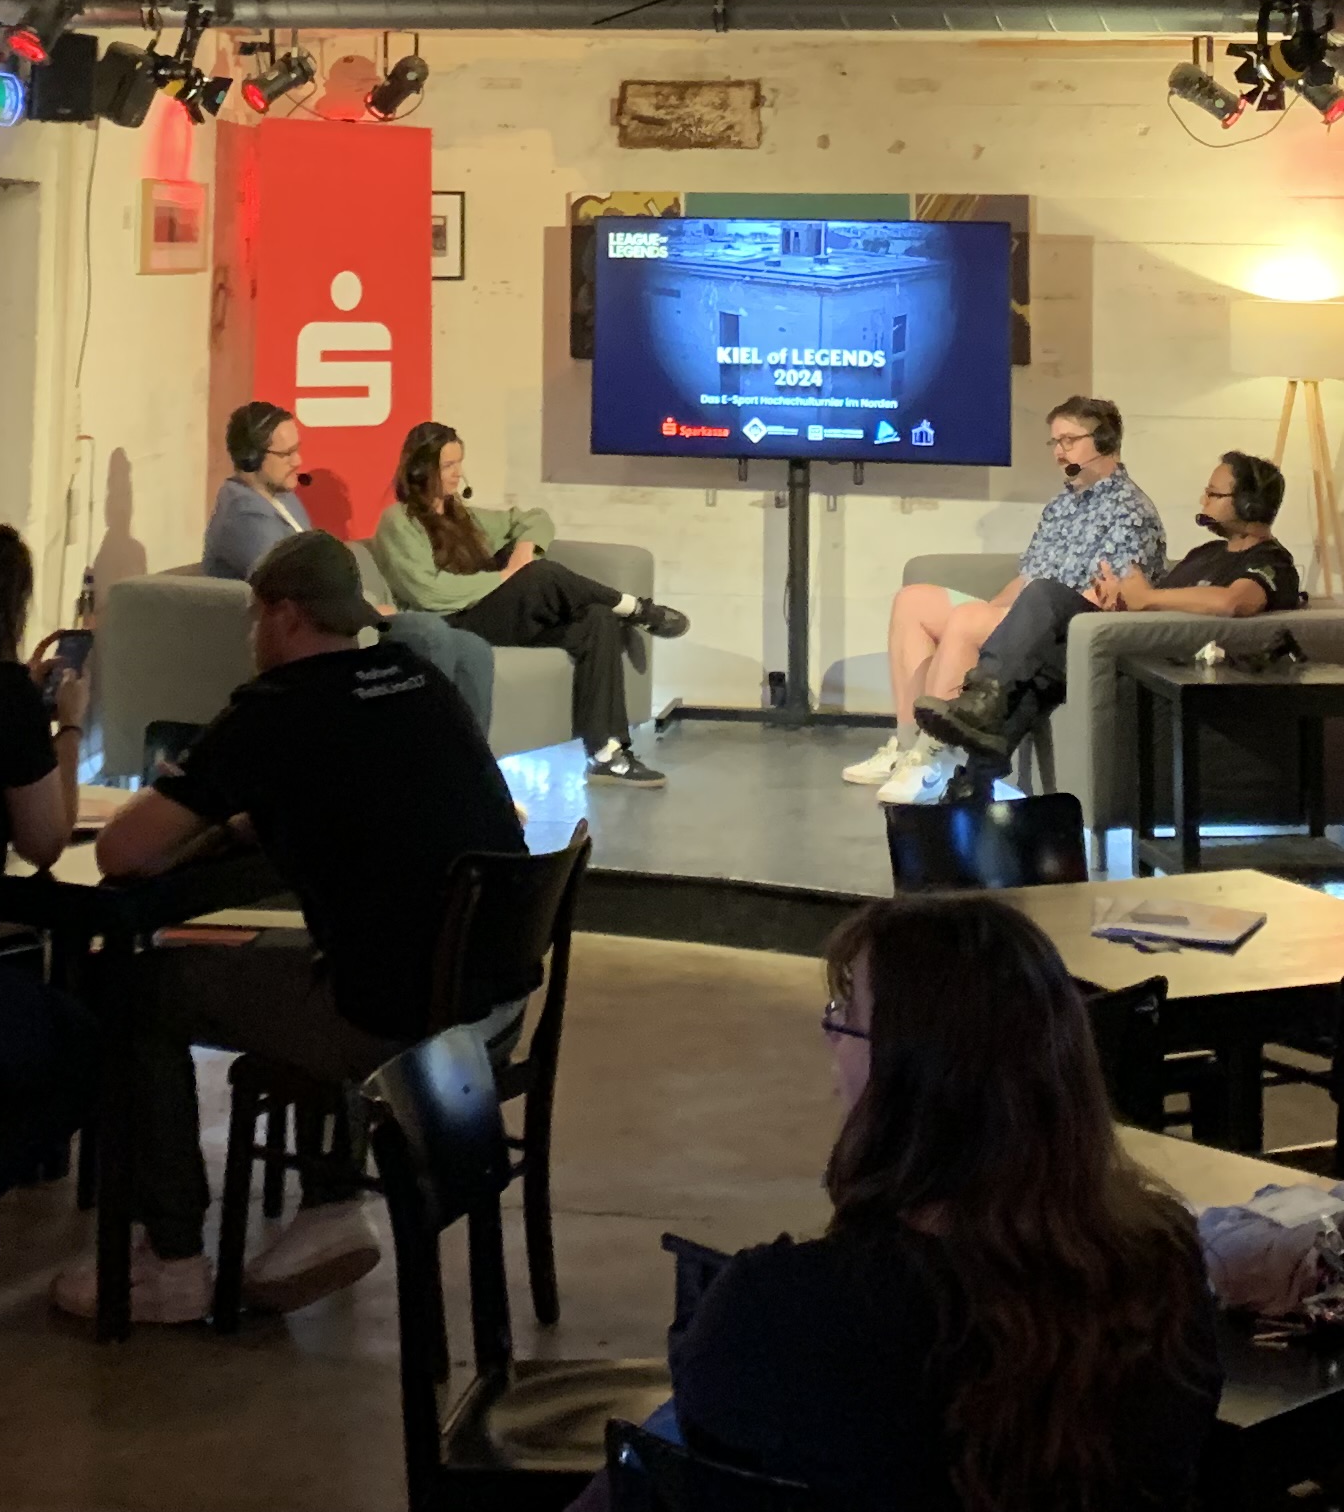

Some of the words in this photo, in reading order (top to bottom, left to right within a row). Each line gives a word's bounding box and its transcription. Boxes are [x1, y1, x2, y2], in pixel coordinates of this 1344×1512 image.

[608, 232, 660, 245] LEAGUE
[608, 245, 669, 258] LEGENDS
[716, 346, 763, 364] KIEL
[766, 348, 788, 366] of
[791, 348, 886, 368] LEGENDS
[773, 368, 824, 388] 2024
[700, 394, 720, 405] Das
[721, 394, 758, 407] E-Sport
[845, 397, 859, 408] im
[860, 398, 898, 409] Norden
[679, 425, 730, 438] Sparkasse
